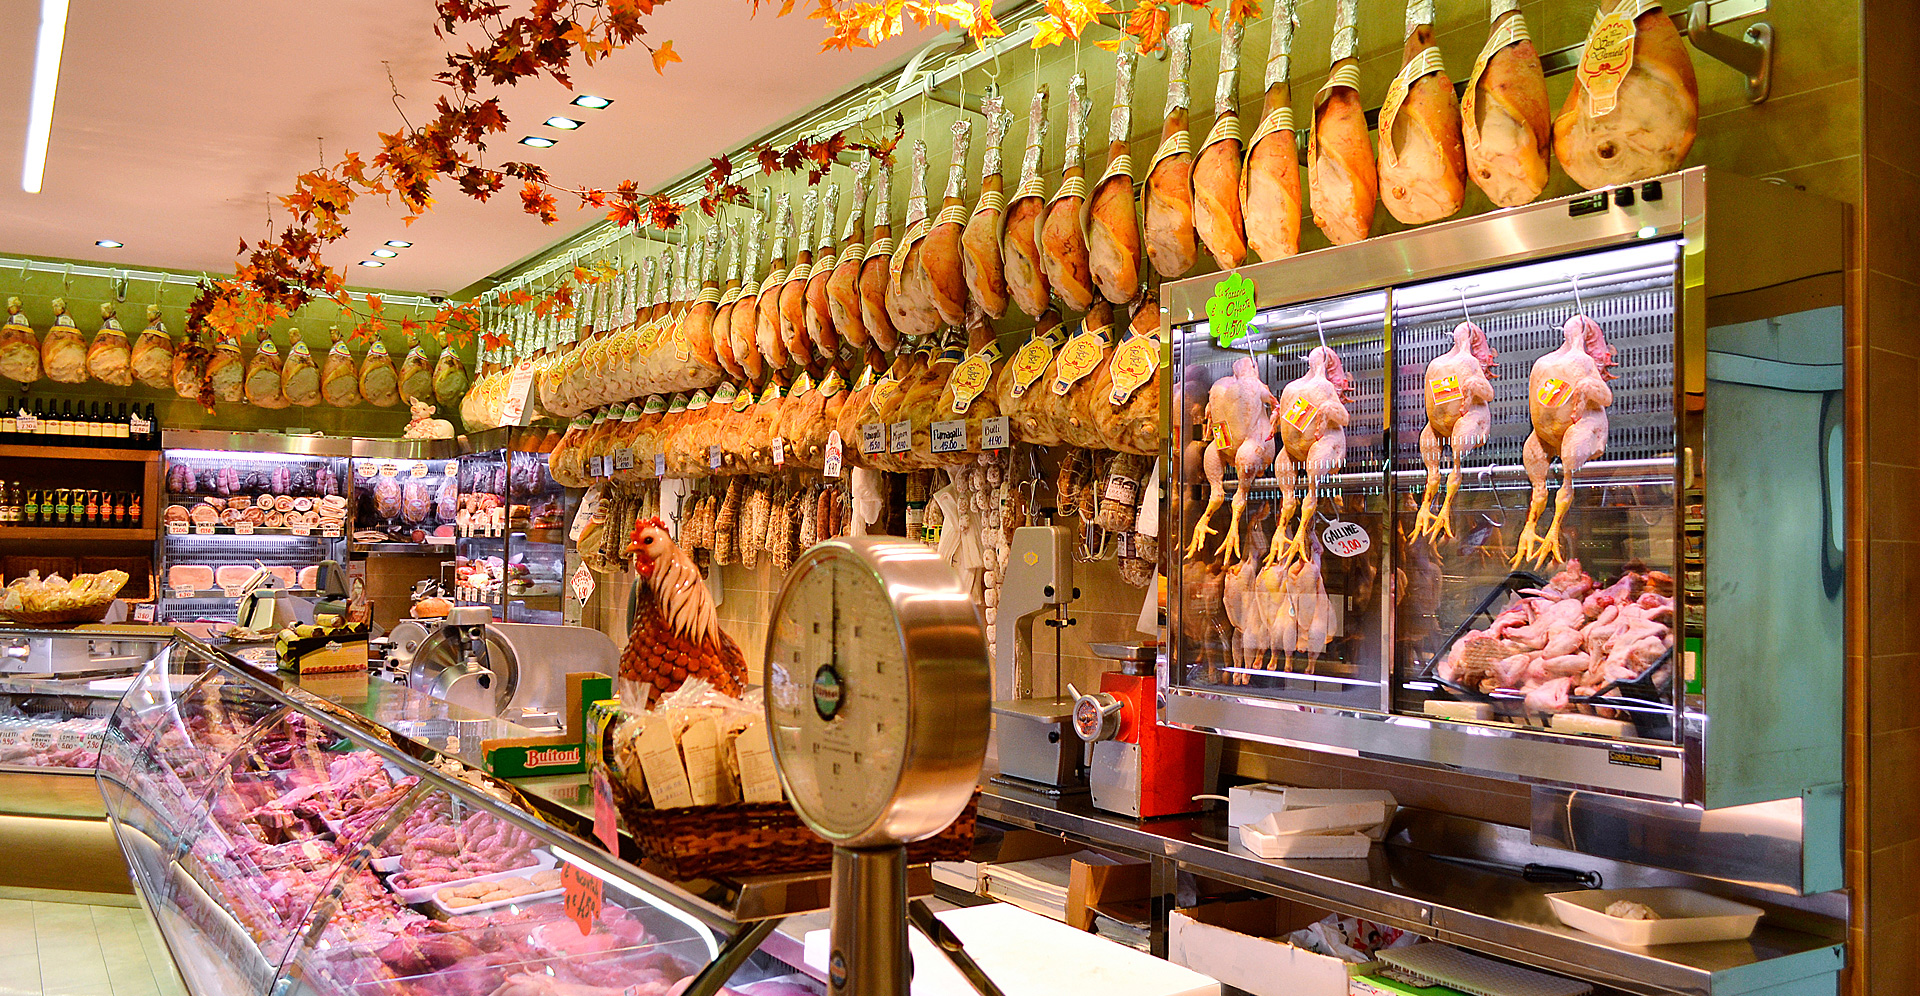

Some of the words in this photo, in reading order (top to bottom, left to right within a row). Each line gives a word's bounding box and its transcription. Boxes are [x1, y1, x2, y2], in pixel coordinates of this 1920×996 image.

[1592, 36, 1615, 51] San
[1591, 47, 1624, 61] Daniele
[933, 427, 962, 445] Fumagalli
[1324, 524, 1360, 545] GALLINE
[525, 748, 580, 768] Buitoni
